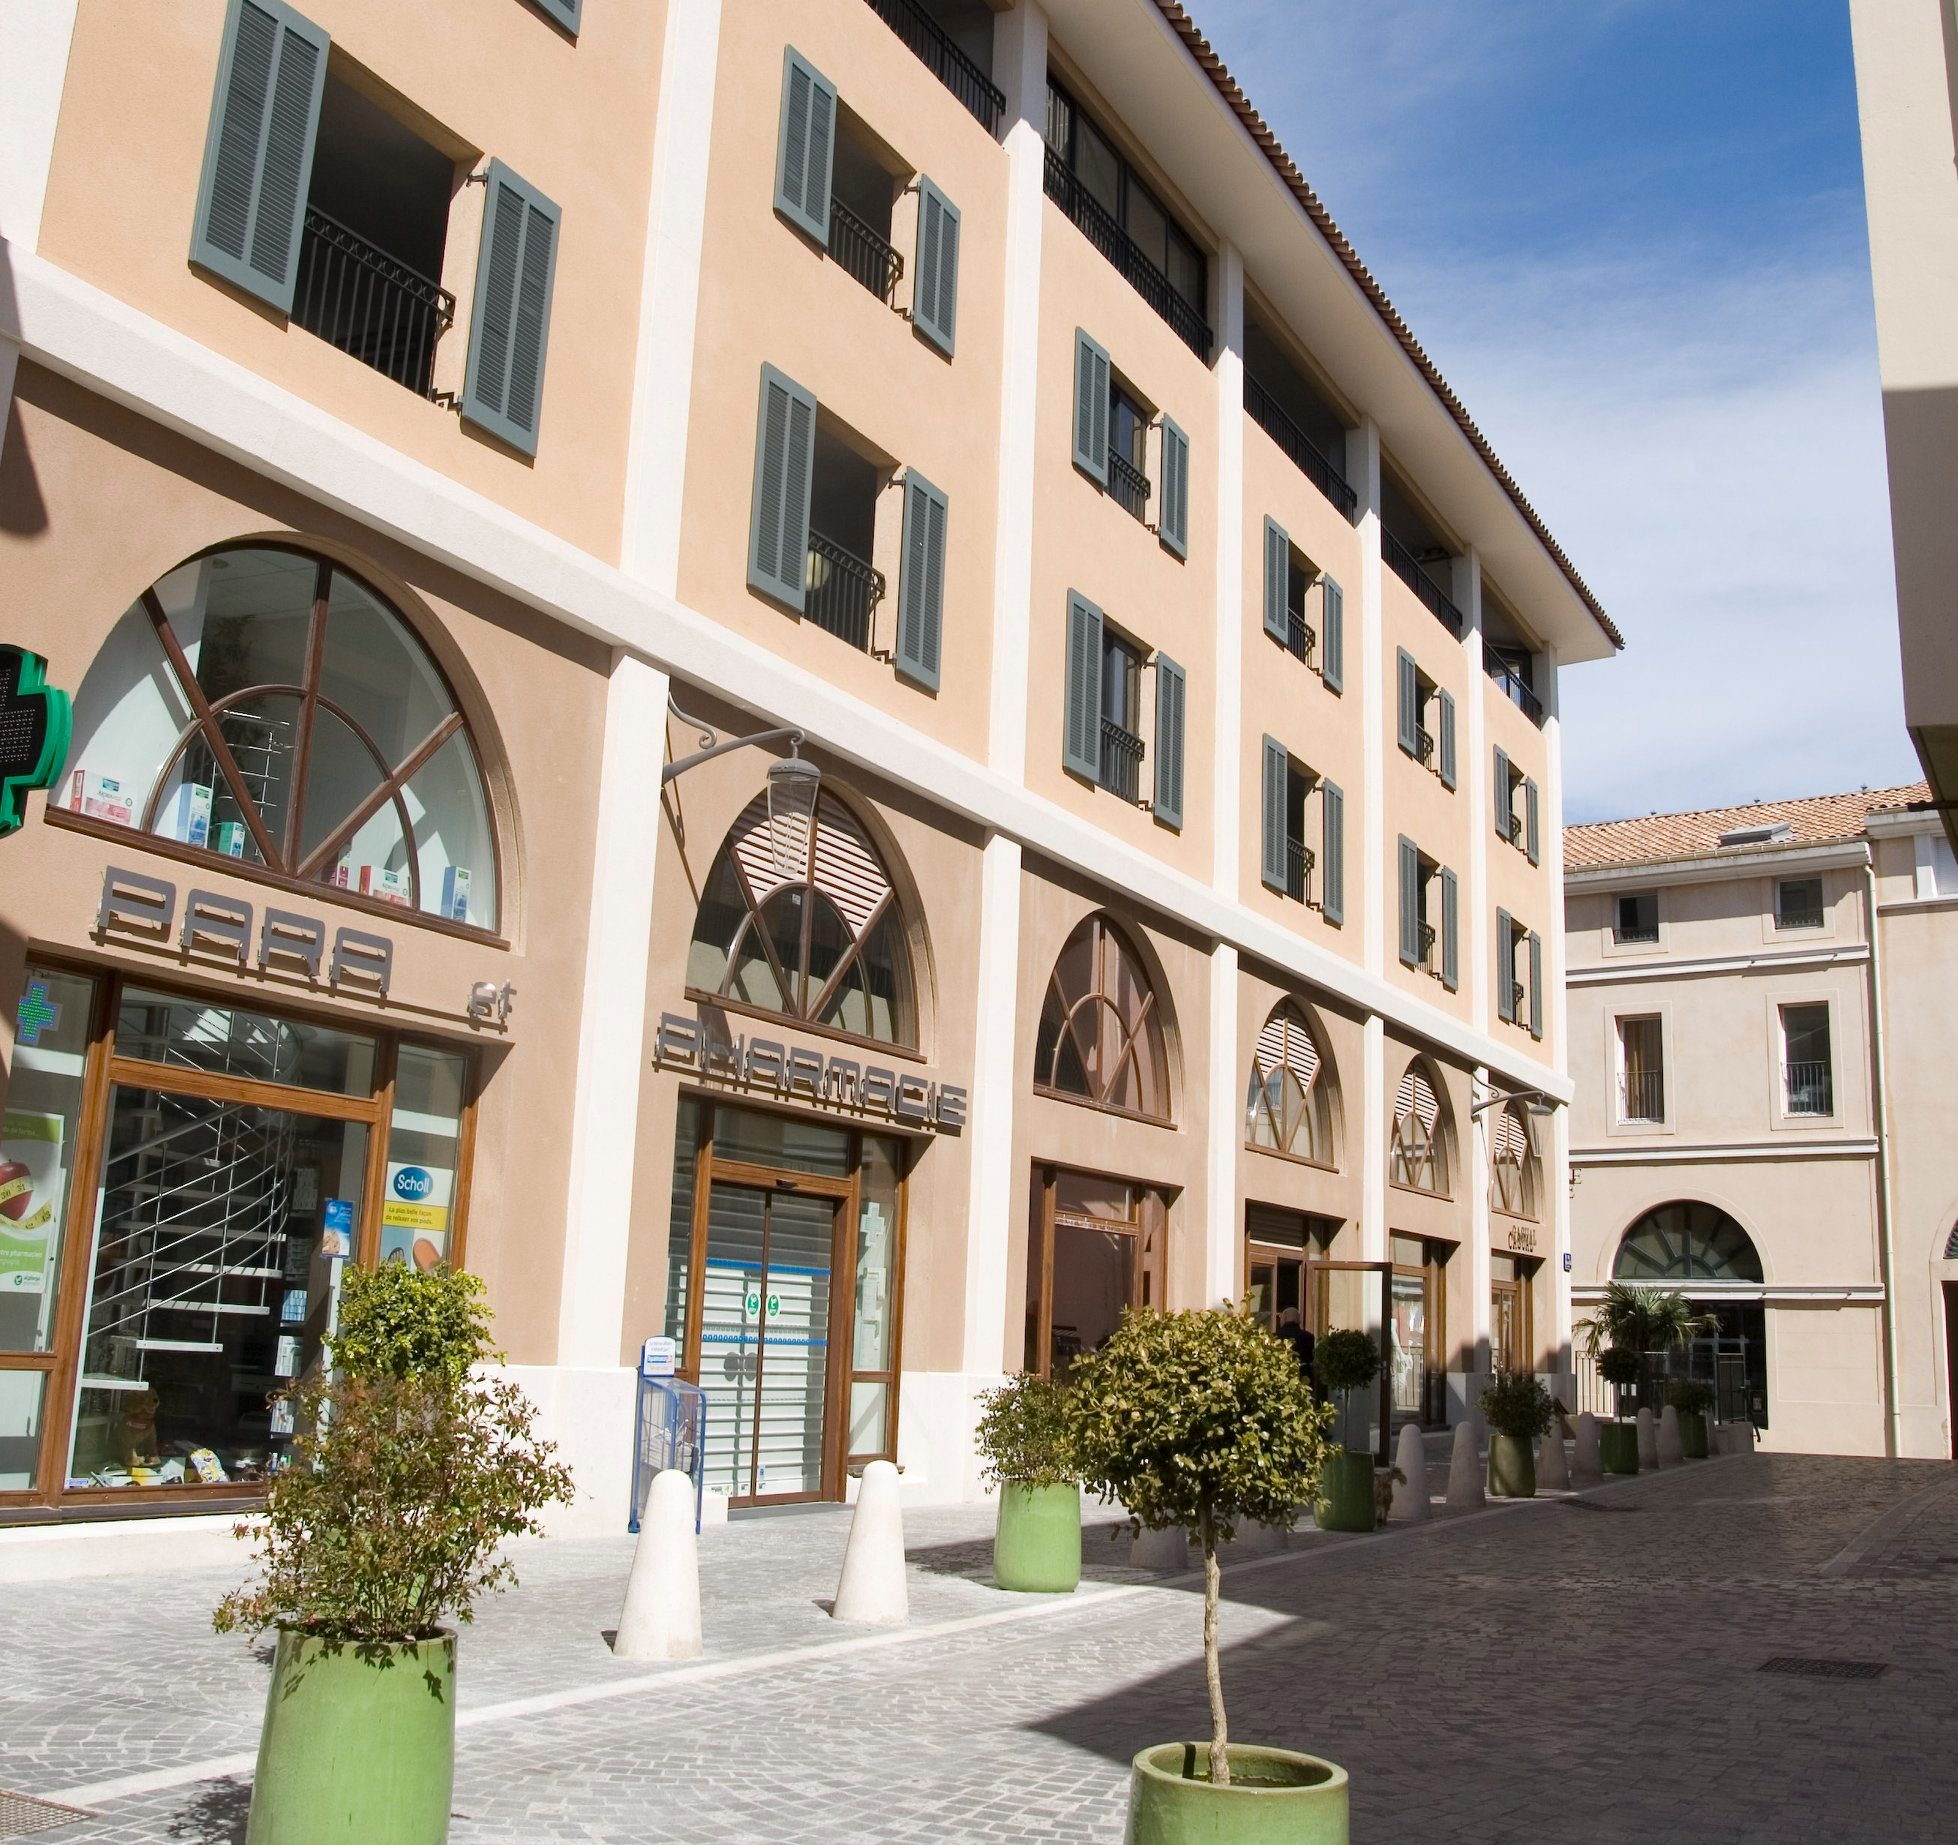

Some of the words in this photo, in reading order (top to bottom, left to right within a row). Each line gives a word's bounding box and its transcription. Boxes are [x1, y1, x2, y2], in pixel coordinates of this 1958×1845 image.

[98, 865, 393, 993] PARA
[467, 979, 516, 1019] et
[657, 1012, 967, 1125] PHARMACIE
[397, 1173, 430, 1193] Scholl
[1508, 1225, 1536, 1251] CASUAL
